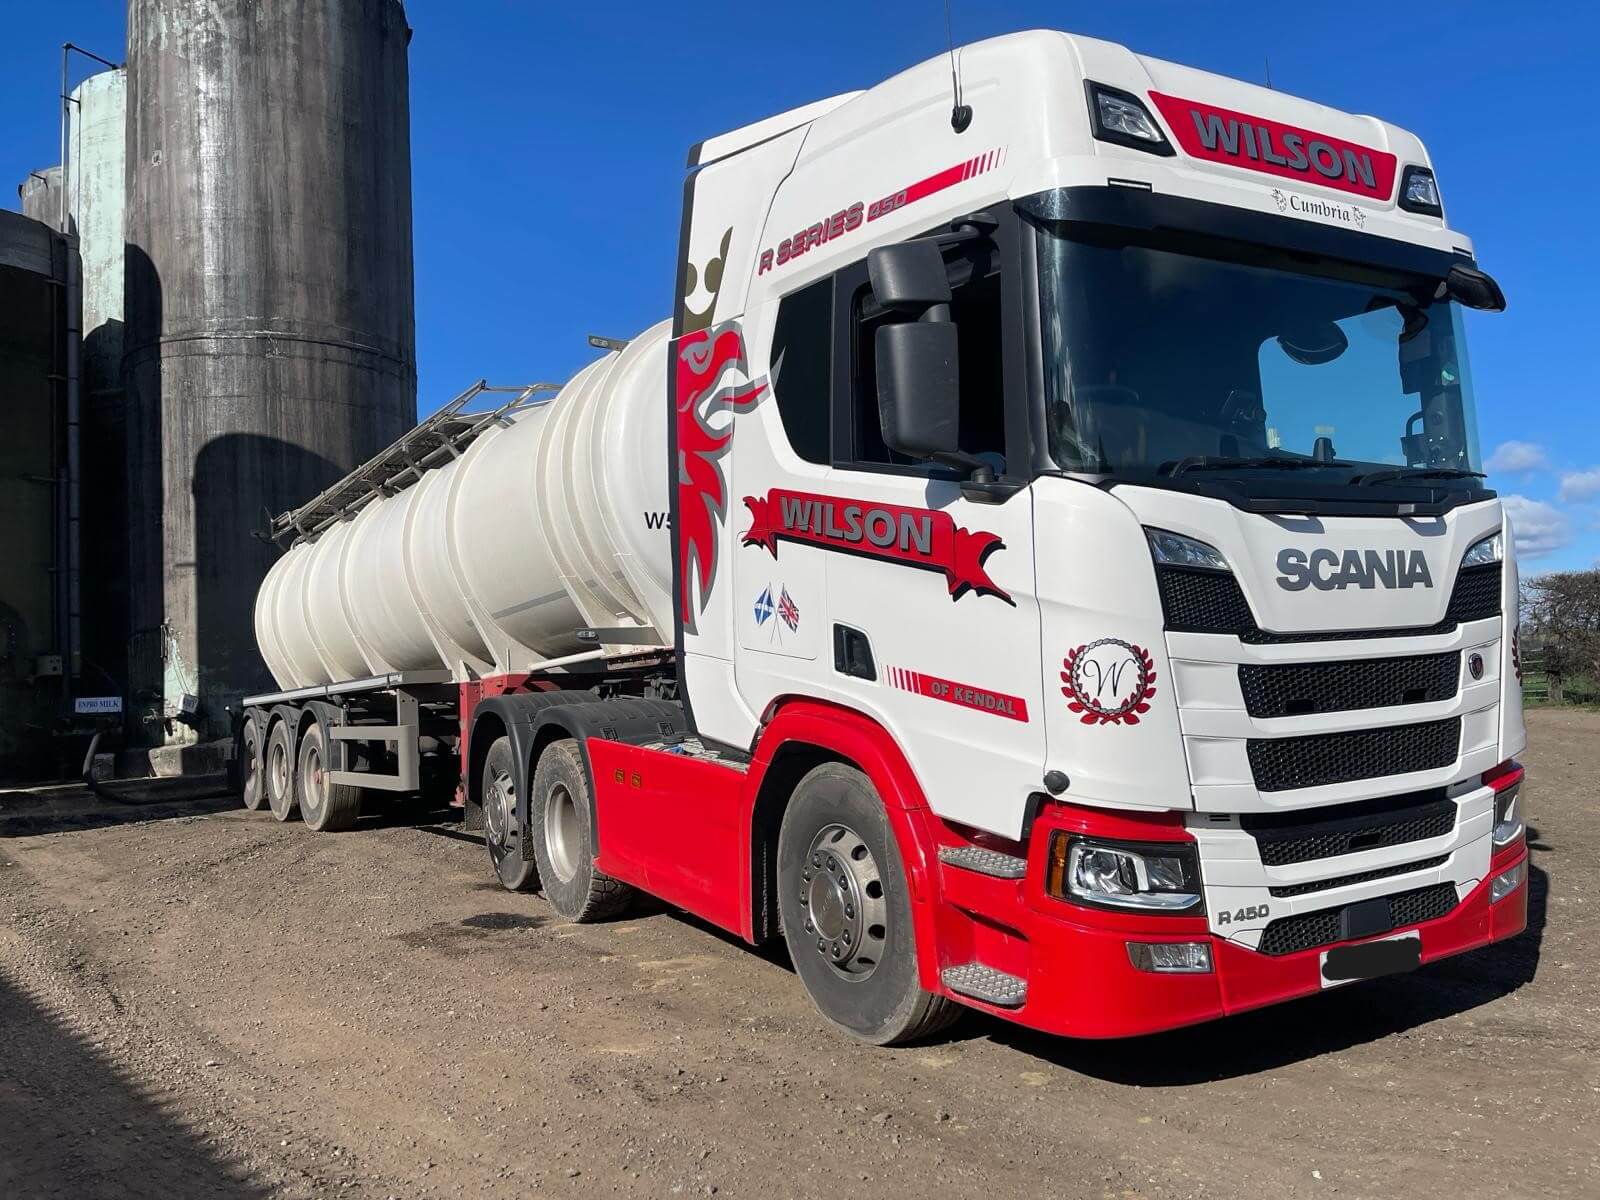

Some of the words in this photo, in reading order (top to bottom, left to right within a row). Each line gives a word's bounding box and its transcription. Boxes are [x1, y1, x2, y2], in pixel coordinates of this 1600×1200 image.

[1190, 109, 1377, 188] WILSON
[1289, 194, 1351, 222] Cumbria
[758, 248, 775, 276] R
[775, 201, 865, 266] SERIES
[868, 190, 908, 220] 450
[779, 495, 934, 555] WILSON
[1276, 547, 1434, 592] SCANIA
[1082, 658, 1137, 698] W
[99, 699, 120, 708] MILK
[931, 681, 950, 697] OF
[953, 686, 1017, 716] KENDAL
[1217, 910, 1232, 926] R
[1233, 903, 1271, 922] 450
